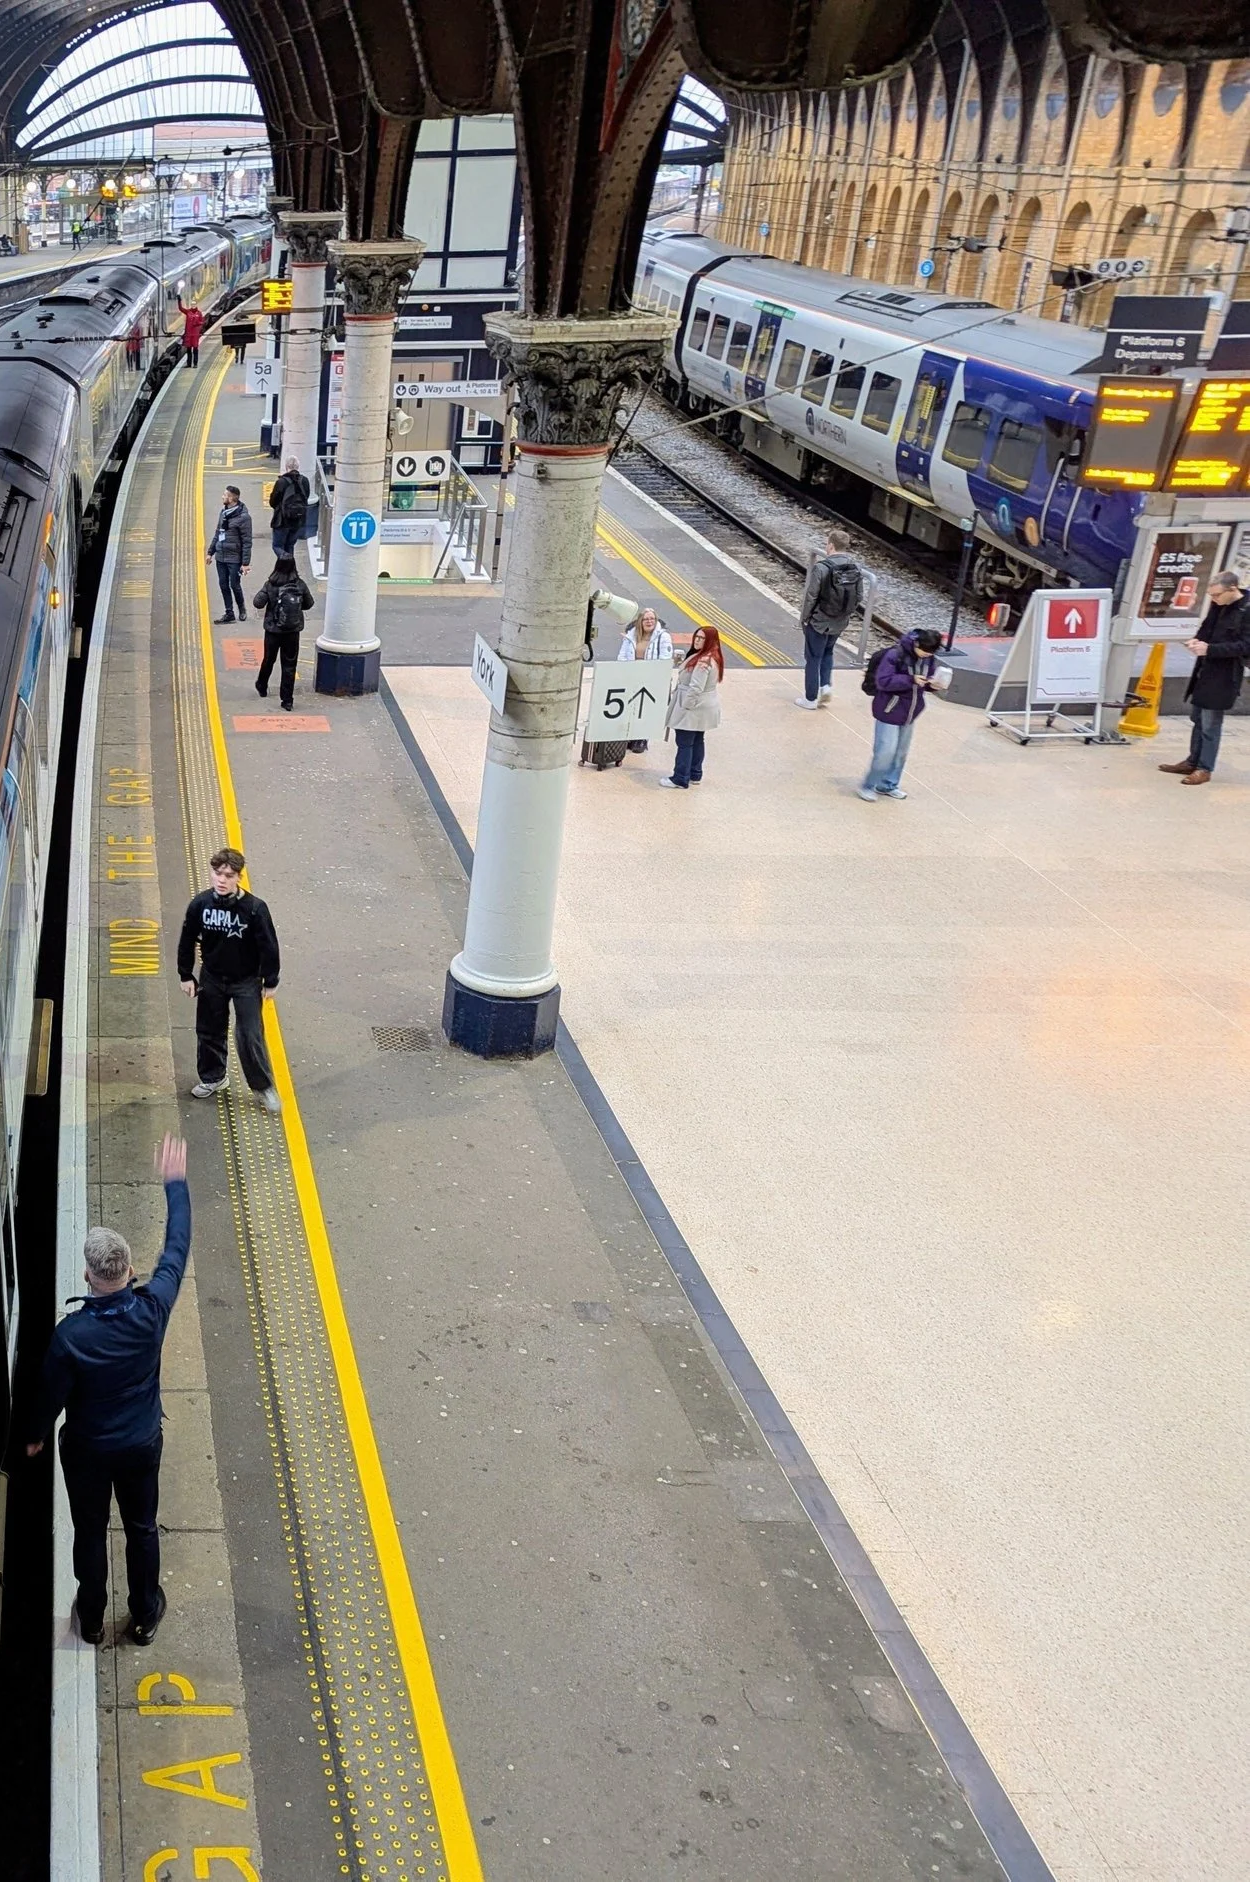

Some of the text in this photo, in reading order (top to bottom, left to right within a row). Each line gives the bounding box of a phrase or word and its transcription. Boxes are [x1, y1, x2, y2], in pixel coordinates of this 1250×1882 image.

[1119, 335, 1186, 347] Platform 6
[1114, 348, 1185, 361] Departures
[254, 361, 272, 375] 5a
[424, 385, 462, 395] Way out
[349, 520, 368, 540] 11
[124, 552, 153, 569] THE
[1158, 552, 1203, 563] £5 free
[1156, 563, 1195, 573] credit
[239, 648, 259, 667] Zone
[476, 643, 495, 691] York
[602, 687, 626, 720] 5
[106, 767, 161, 975] MIND THE GAP
[202, 908, 232, 928] CAPA
[136, 1671, 261, 1882] GAP
